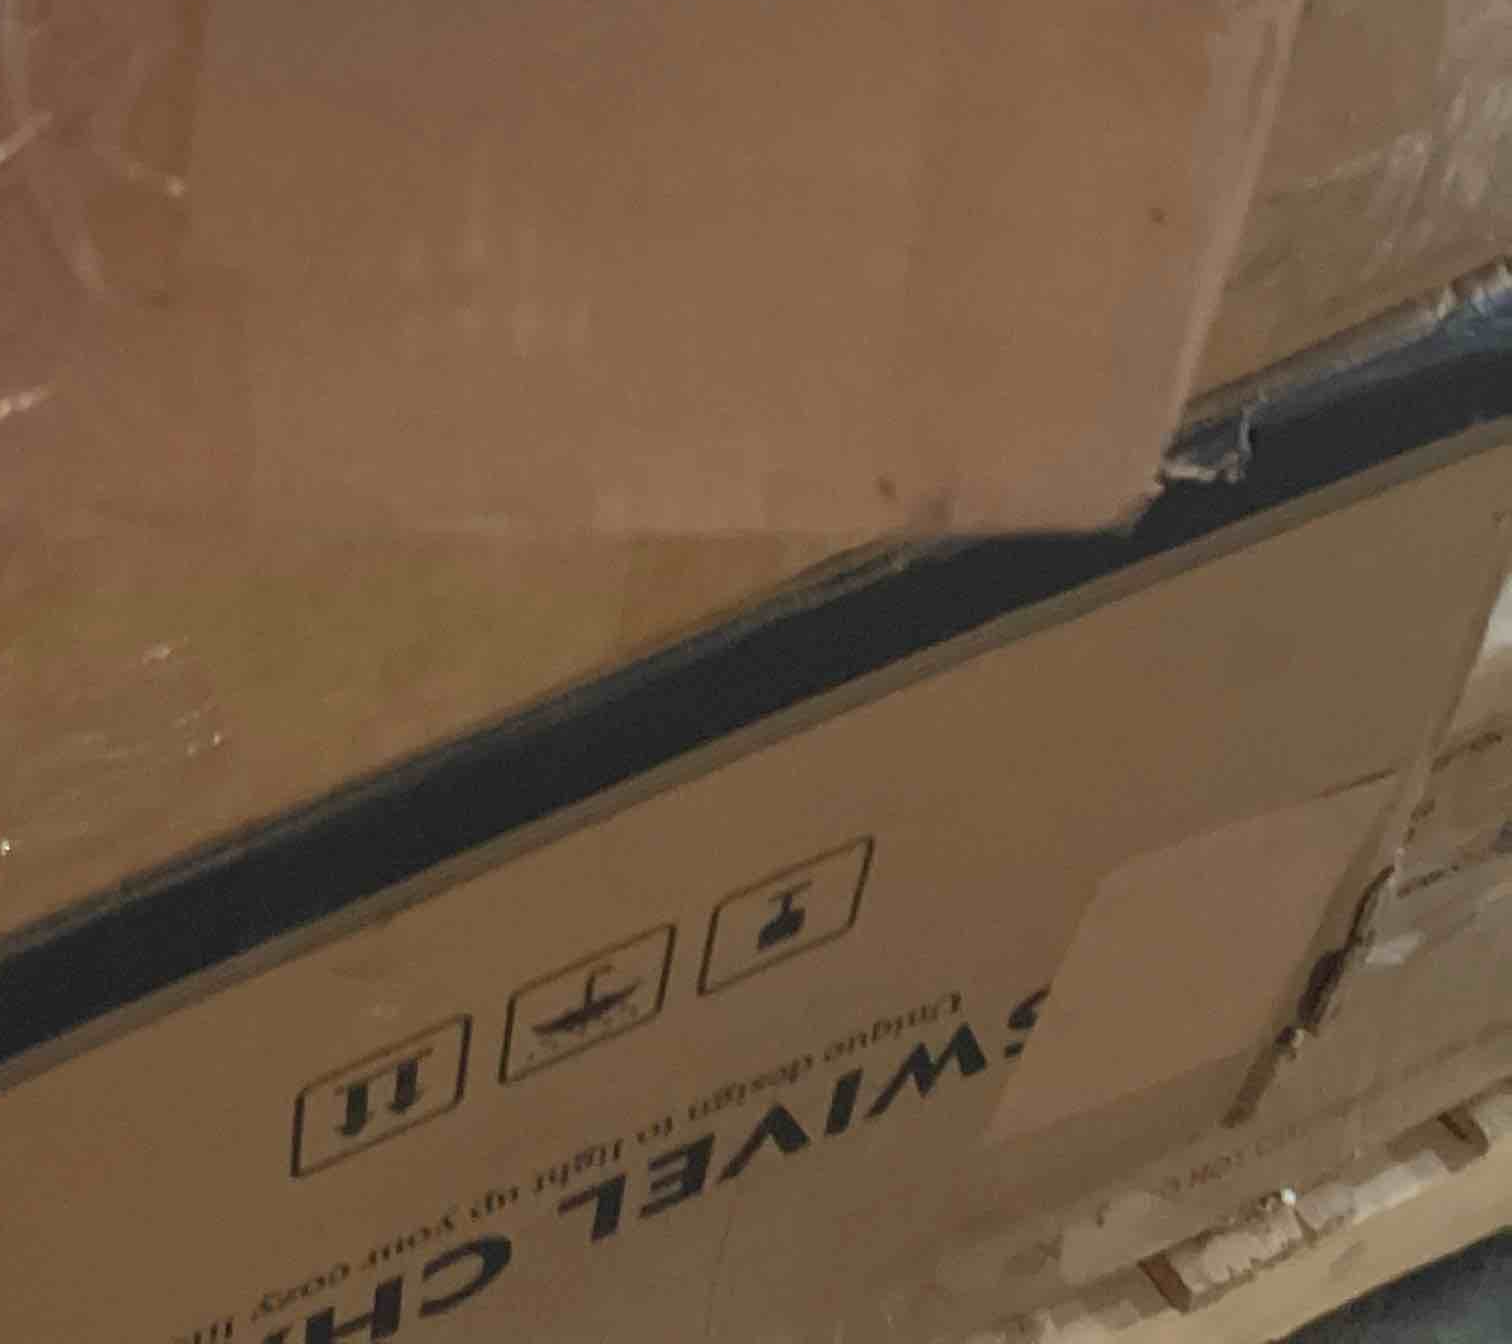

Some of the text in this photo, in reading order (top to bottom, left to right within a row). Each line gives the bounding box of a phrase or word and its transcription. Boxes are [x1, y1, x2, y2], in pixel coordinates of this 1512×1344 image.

[823, 992, 964, 1062] Unique
[688, 1054, 814, 1121] design
[634, 1116, 674, 1147] to
[534, 1138, 624, 1193] light
[469, 1185, 520, 1223] up
[260, 1234, 513, 1344] CH
